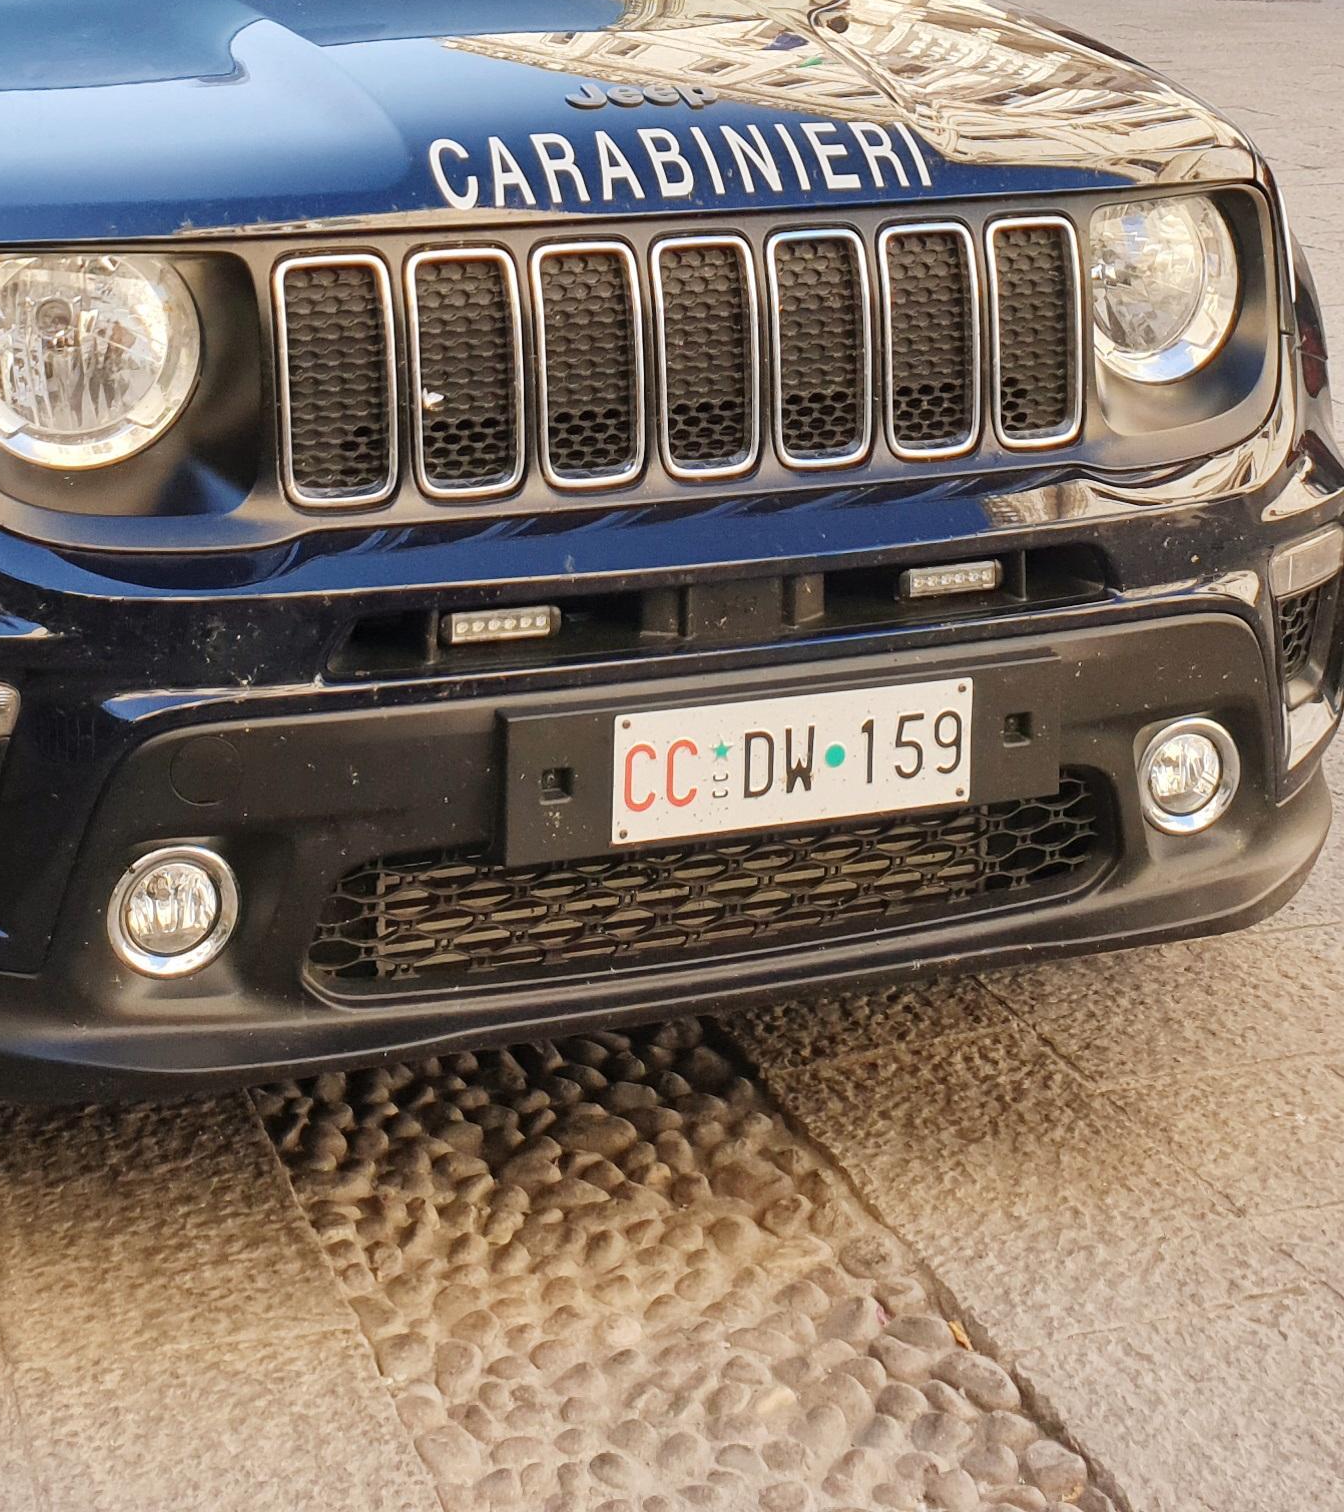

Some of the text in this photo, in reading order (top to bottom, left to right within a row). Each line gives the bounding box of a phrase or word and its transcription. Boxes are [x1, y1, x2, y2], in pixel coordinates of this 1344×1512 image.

[565, 83, 720, 109] Jeep
[428, 121, 932, 211] CARABINIERI
[623, 709, 963, 812] CC DW 159
